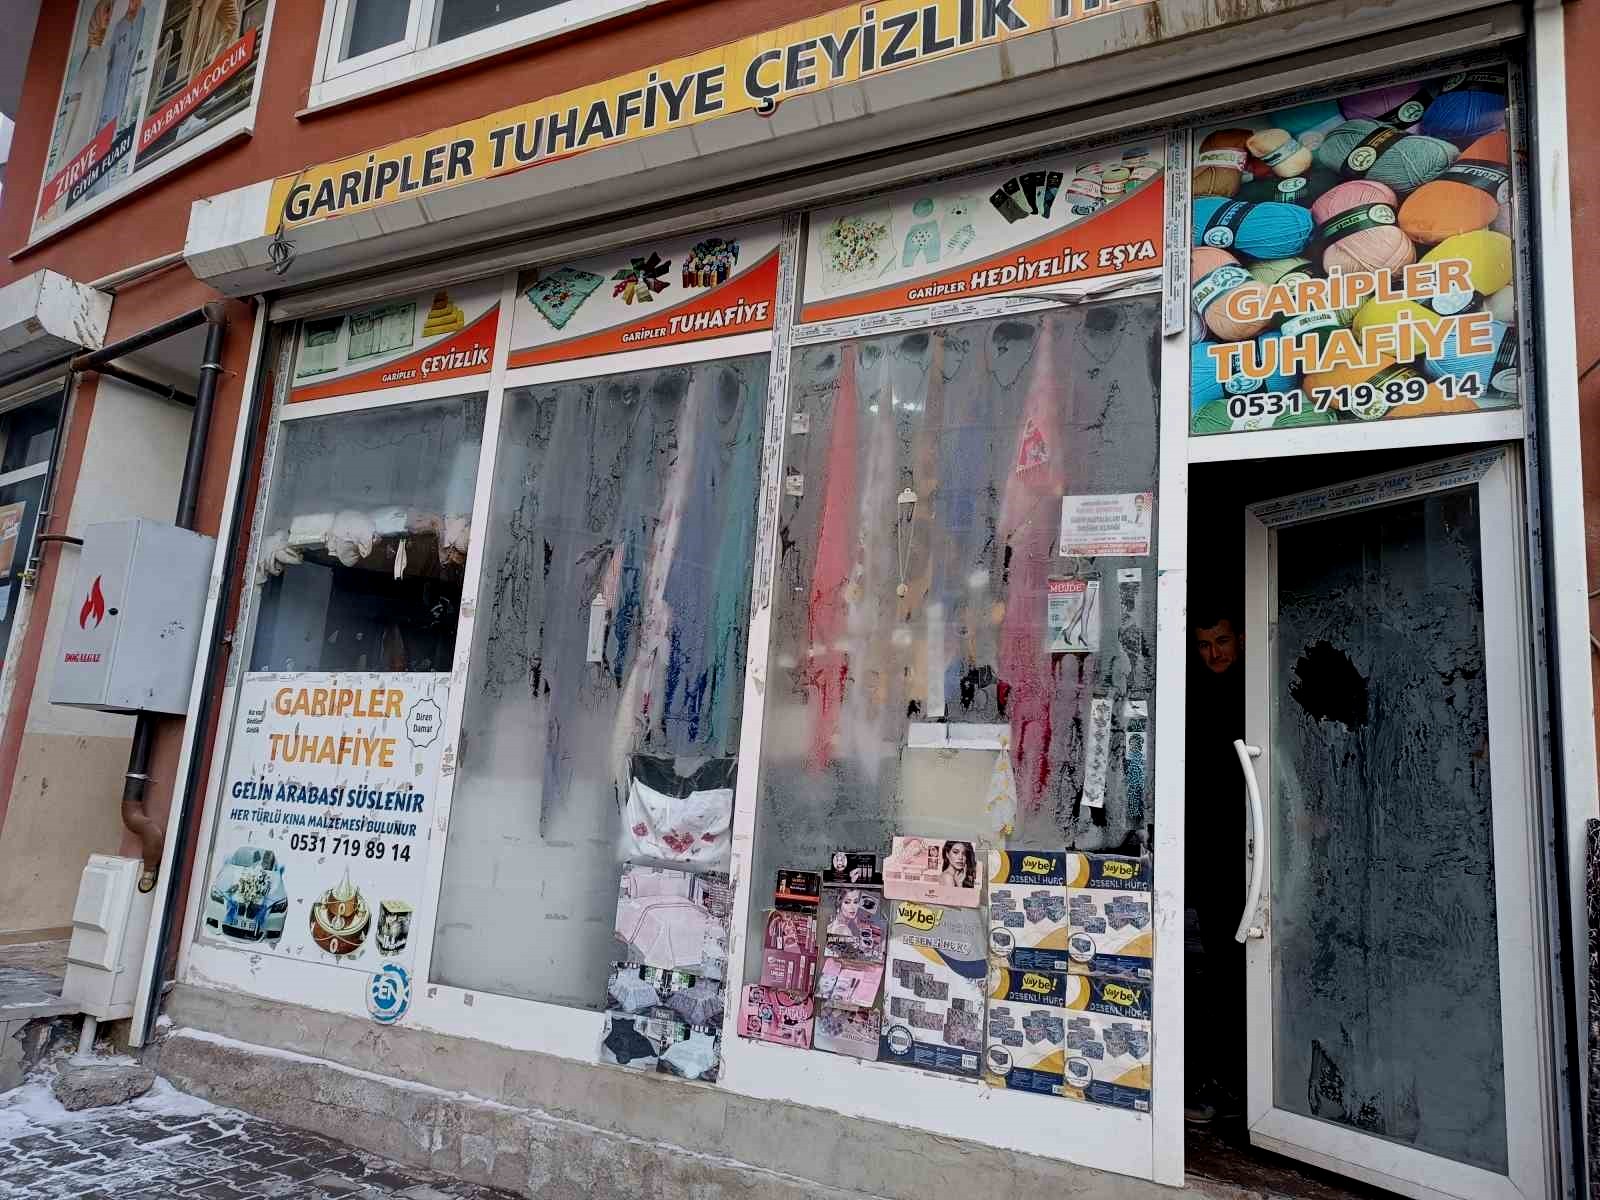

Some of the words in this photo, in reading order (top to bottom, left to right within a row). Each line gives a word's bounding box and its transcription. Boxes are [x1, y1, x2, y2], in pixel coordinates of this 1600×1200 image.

[284, 138, 476, 222] GARİPLER
[488, 64, 727, 169] TUHAFİYE
[908, 280, 966, 300] GARİPLER
[970, 248, 1089, 291] HEDİYELİK
[1097, 240, 1156, 270] EŞYA
[1226, 258, 1474, 323] GARİPLER
[622, 327, 667, 343] GARİPLER
[669, 298, 770, 335] TUHAFİYE
[421, 343, 490, 378] ÇEYİZLİK
[1208, 311, 1494, 383] TUHAFİYE
[1228, 391, 1302, 420] 0531
[1315, 386, 1375, 411] 719
[1384, 380, 1427, 405] 89
[1438, 374, 1483, 399] 14
[274, 680, 405, 719] GARİPLER
[268, 728, 397, 768] TUHAFİYE
[232, 776, 273, 801] GELİN
[275, 783, 345, 807] ARABASI
[346, 784, 425, 813] SÜSLENİR
[230, 808, 250, 821] HER
[251, 809, 282, 824] TÜRLÜ
[282, 813, 306, 826] KINA
[307, 815, 366, 832] MALZEMESİ
[366, 821, 417, 837] BULUNUR
[290, 833, 327, 854] 0531
[331, 837, 361, 858] 719
[365, 840, 385, 860] 89
[391, 843, 411, 863] 14
